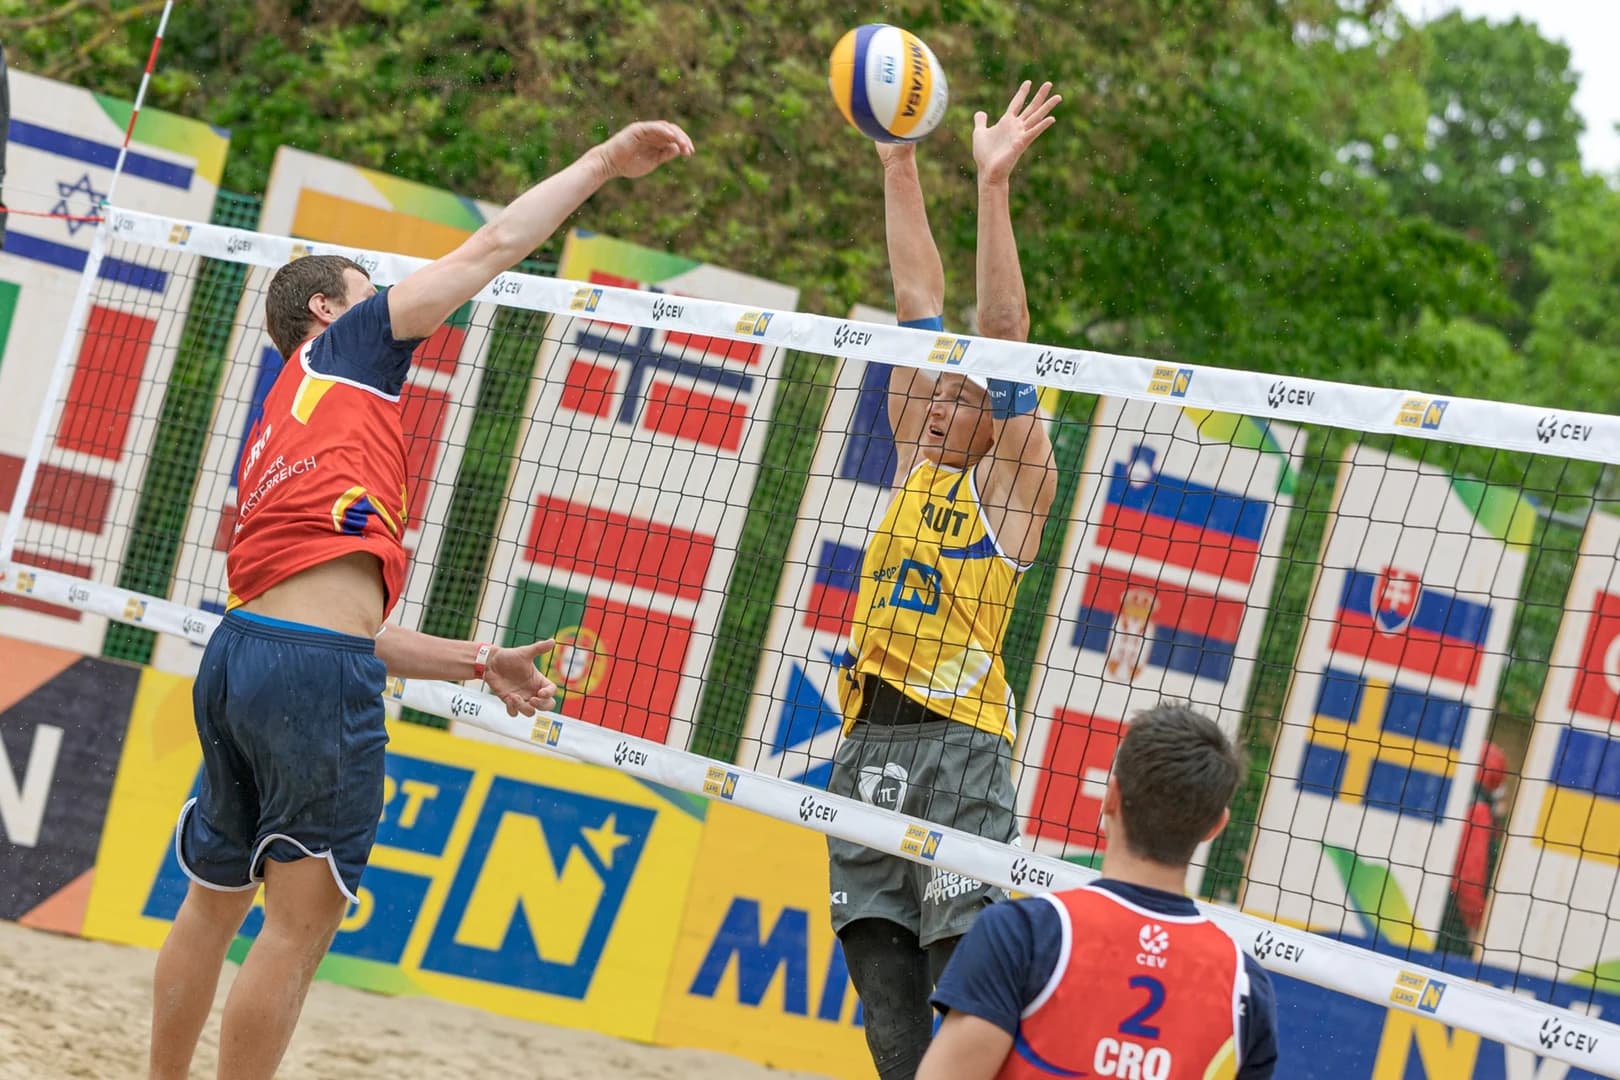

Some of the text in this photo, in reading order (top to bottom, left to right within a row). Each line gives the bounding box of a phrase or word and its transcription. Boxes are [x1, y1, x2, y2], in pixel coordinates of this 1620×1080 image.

[901, 42, 924, 117] MIKASA
[505, 281, 522, 295] CEV
[665, 304, 685, 319] CEV
[848, 331, 872, 347] CEV
[1053, 359, 1080, 377] CEV
[1287, 388, 1316, 407] CEV
[1559, 423, 1593, 442] CEV
[920, 502, 969, 537] AUT
[873, 566, 900, 582] SPOR
[463, 700, 482, 717] CEV
[628, 750, 648, 767] CEV
[815, 804, 838, 823] CEV
[1029, 869, 1055, 888] CEV
[454, 811, 606, 967] N
[1136, 953, 1167, 969] CEV
[1274, 942, 1305, 964] CEV
[1399, 973, 1424, 988] SPORT
[1117, 975, 1166, 1040] 2
[1563, 1030, 1600, 1055] CEV
[1093, 1036, 1172, 1080] CRO
